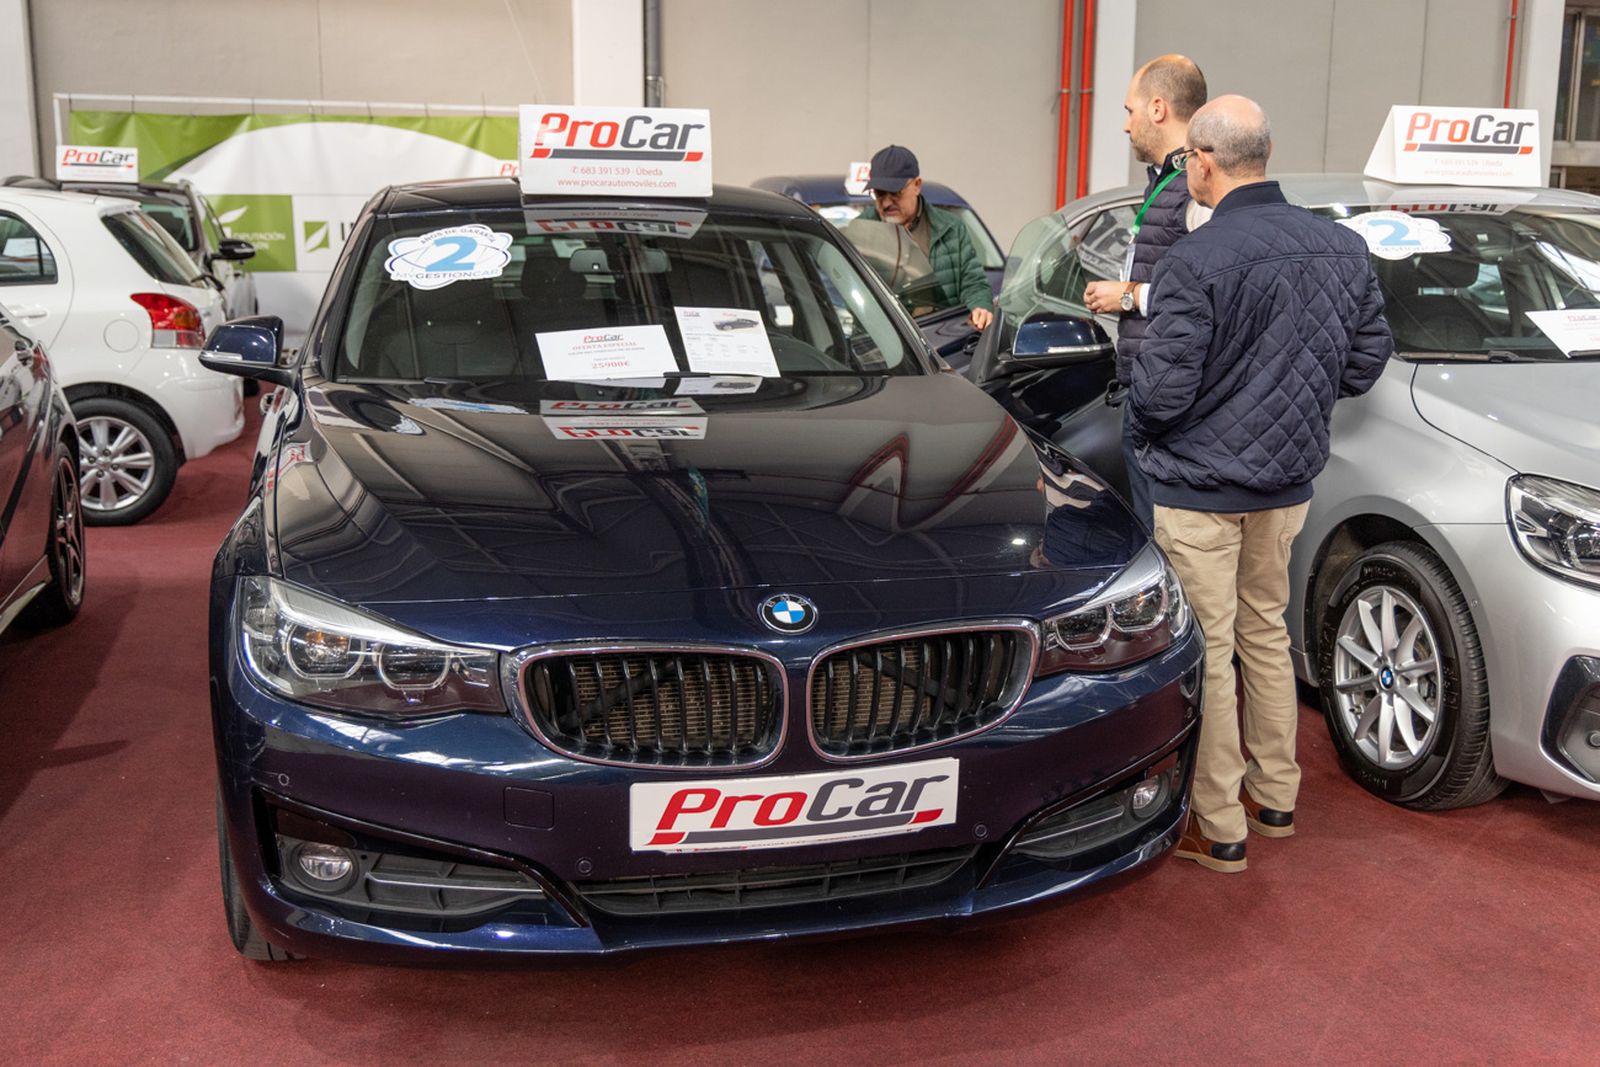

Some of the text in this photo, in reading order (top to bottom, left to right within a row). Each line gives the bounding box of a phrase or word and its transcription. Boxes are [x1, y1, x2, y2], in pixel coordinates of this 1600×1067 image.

[535, 113, 705, 150] ProCar
[1405, 112, 1534, 145] ProCar
[62, 149, 134, 164] ProCar
[580, 166, 597, 175] 683
[598, 166, 613, 175] 391
[614, 166, 631, 175] 539
[1367, 219, 1421, 246] 2
[425, 236, 478, 272] 2
[584, 334, 624, 343] ProCar
[655, 774, 950, 830] ProCar
